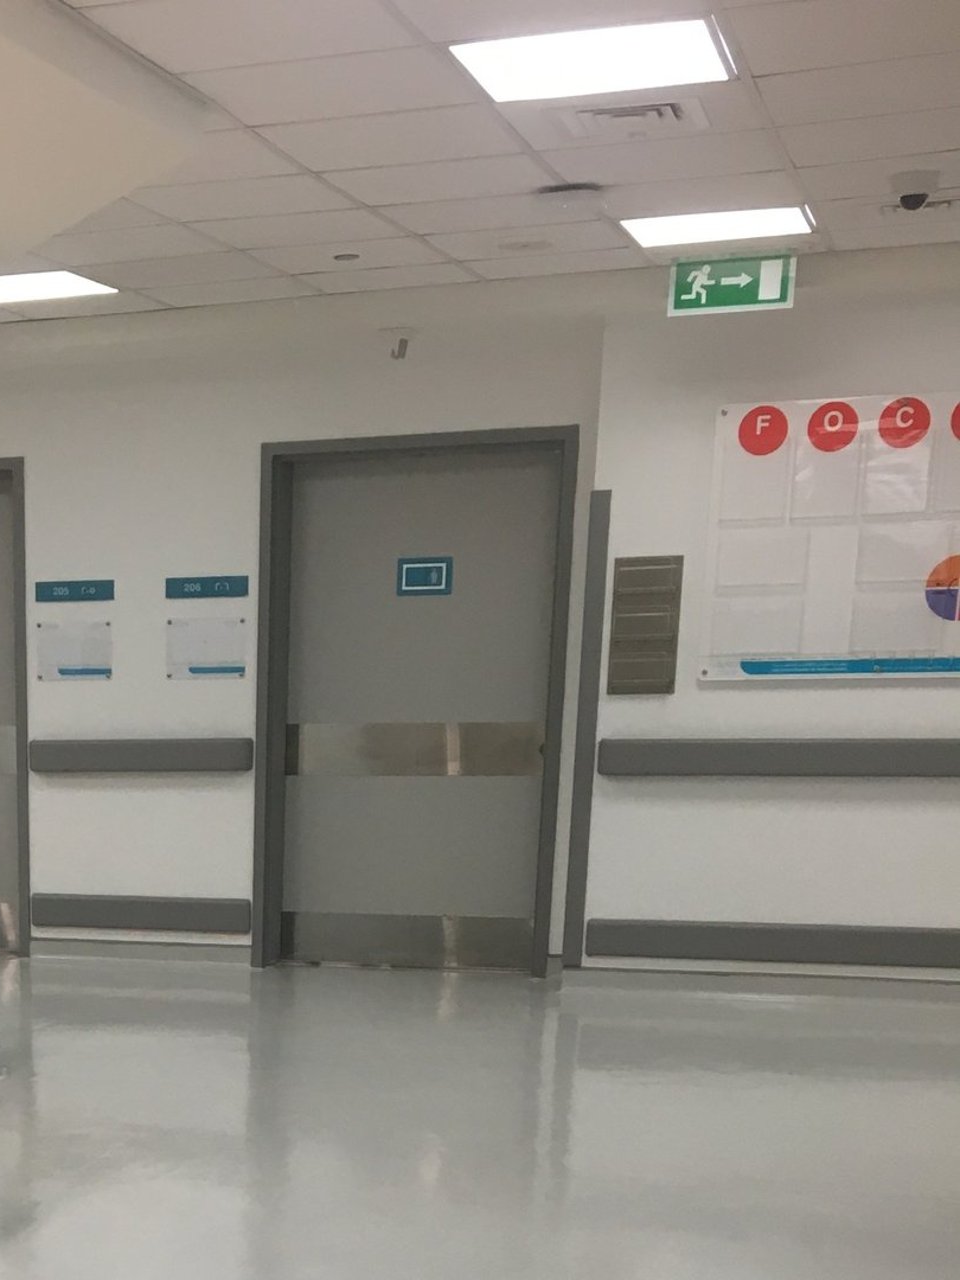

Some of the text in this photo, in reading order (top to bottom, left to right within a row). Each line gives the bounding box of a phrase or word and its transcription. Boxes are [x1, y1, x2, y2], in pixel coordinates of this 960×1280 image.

[756, 406, 915, 435] F O C
